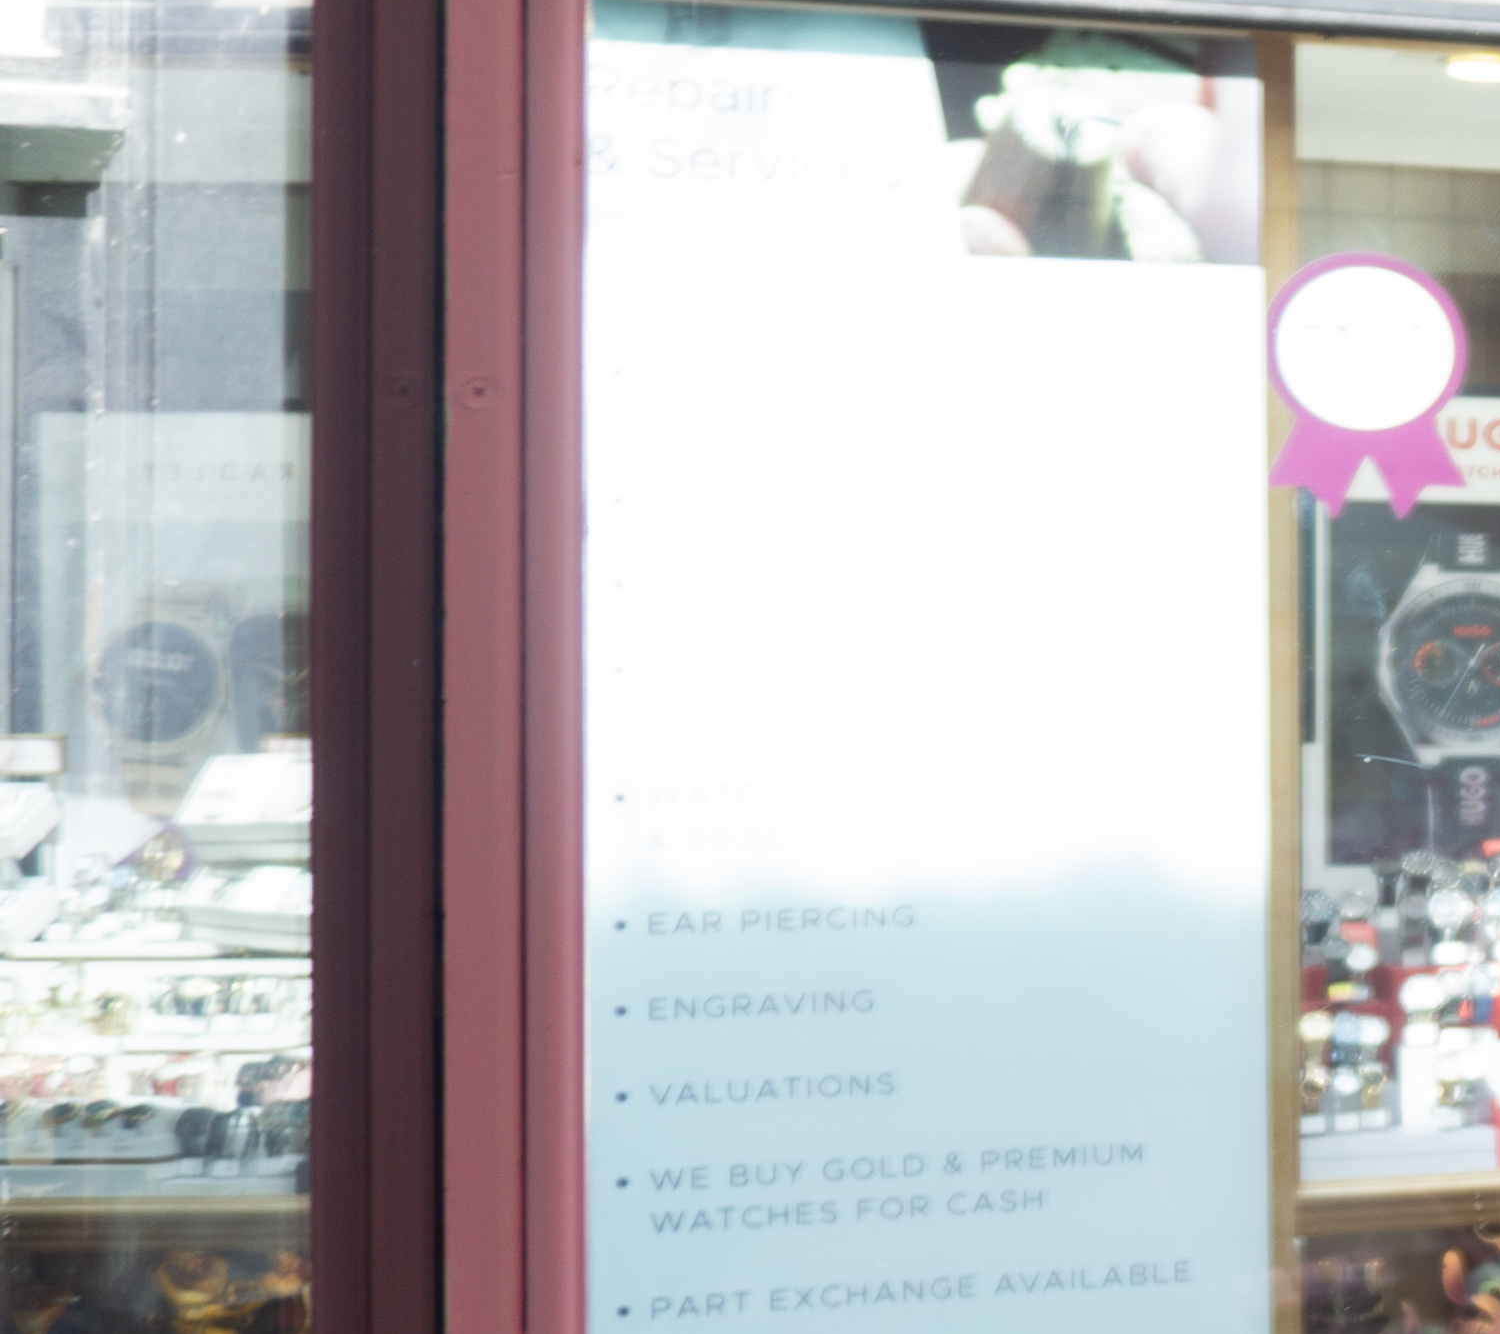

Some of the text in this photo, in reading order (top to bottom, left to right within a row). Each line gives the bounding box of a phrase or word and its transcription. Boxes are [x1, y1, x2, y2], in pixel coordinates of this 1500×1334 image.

[646, 137, 904, 190] Services
[648, 905, 917, 936] EAR PIERCING
[648, 988, 877, 1022] ENGRAVING
[649, 1072, 898, 1107] VALUATIONS
[649, 1141, 1147, 1193] WE BUY GOLD & PREMIUM
[649, 1188, 1048, 1235] WATCHES FOR CASH
[651, 1259, 1193, 1322] PART EXCHANGE AVAILABLE
